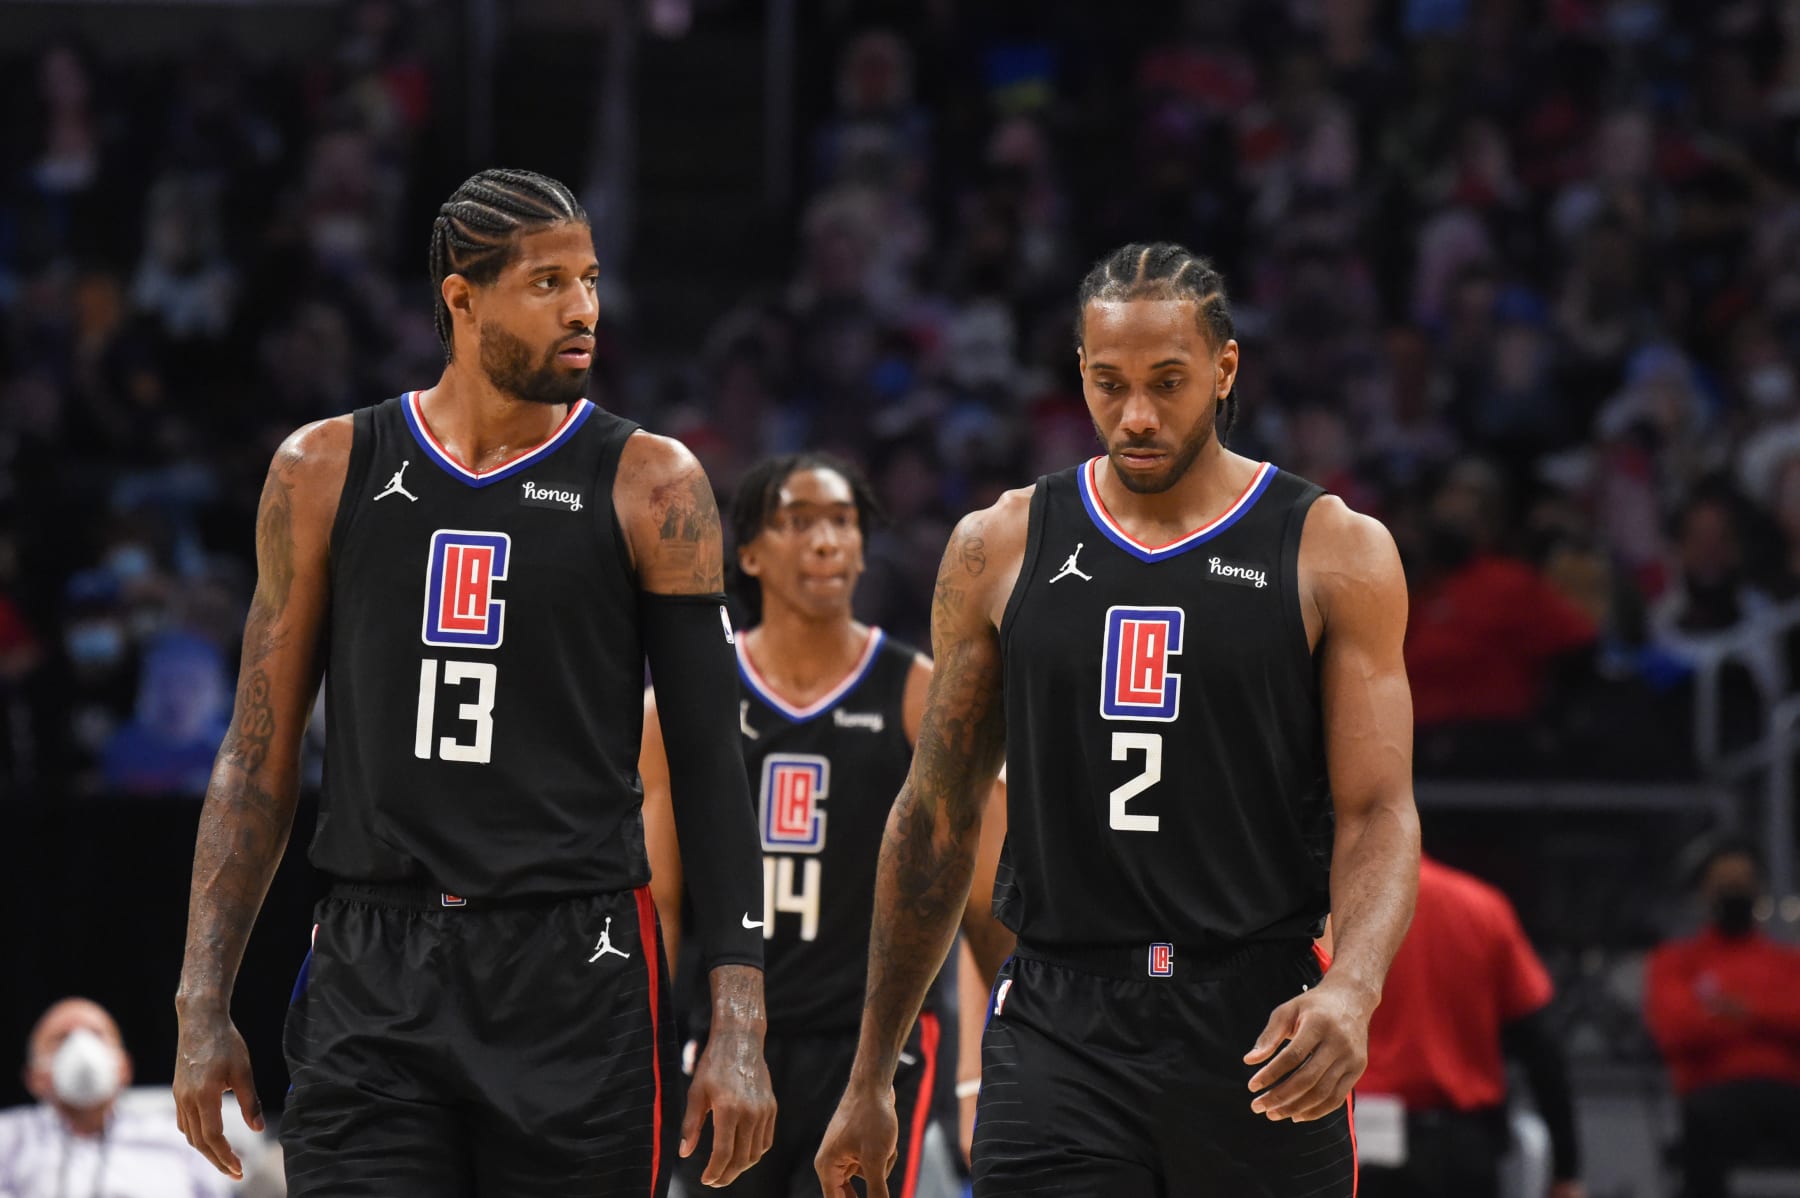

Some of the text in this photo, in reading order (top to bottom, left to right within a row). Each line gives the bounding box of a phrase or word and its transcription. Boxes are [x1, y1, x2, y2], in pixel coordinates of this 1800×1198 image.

[522, 481, 583, 511] honey
[1209, 557, 1267, 588] honey
[414, 658, 497, 763] 13
[1109, 732, 1162, 832] 2
